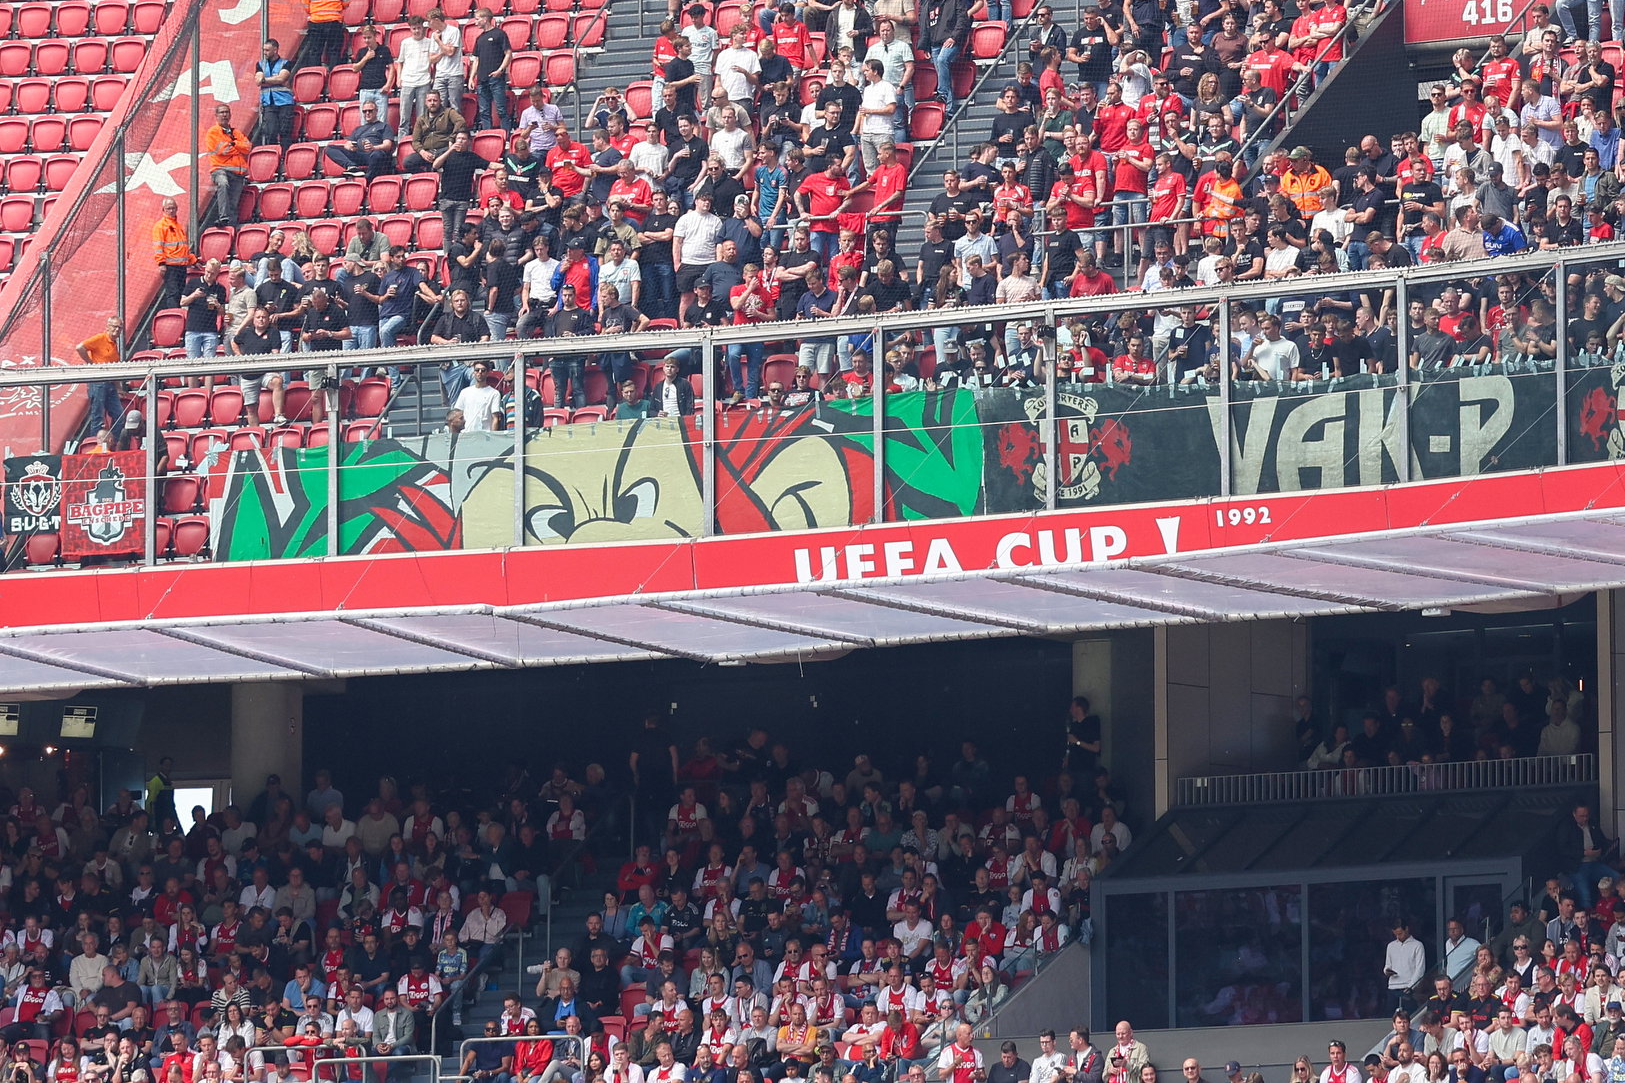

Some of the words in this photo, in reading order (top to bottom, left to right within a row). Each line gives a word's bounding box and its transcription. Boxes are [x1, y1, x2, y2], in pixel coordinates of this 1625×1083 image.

[70, 500, 144, 518] BAGPIPE
[1216, 506, 1273, 528] 1992
[793, 537, 964, 585] UEFA
[995, 524, 1128, 569] CUP
